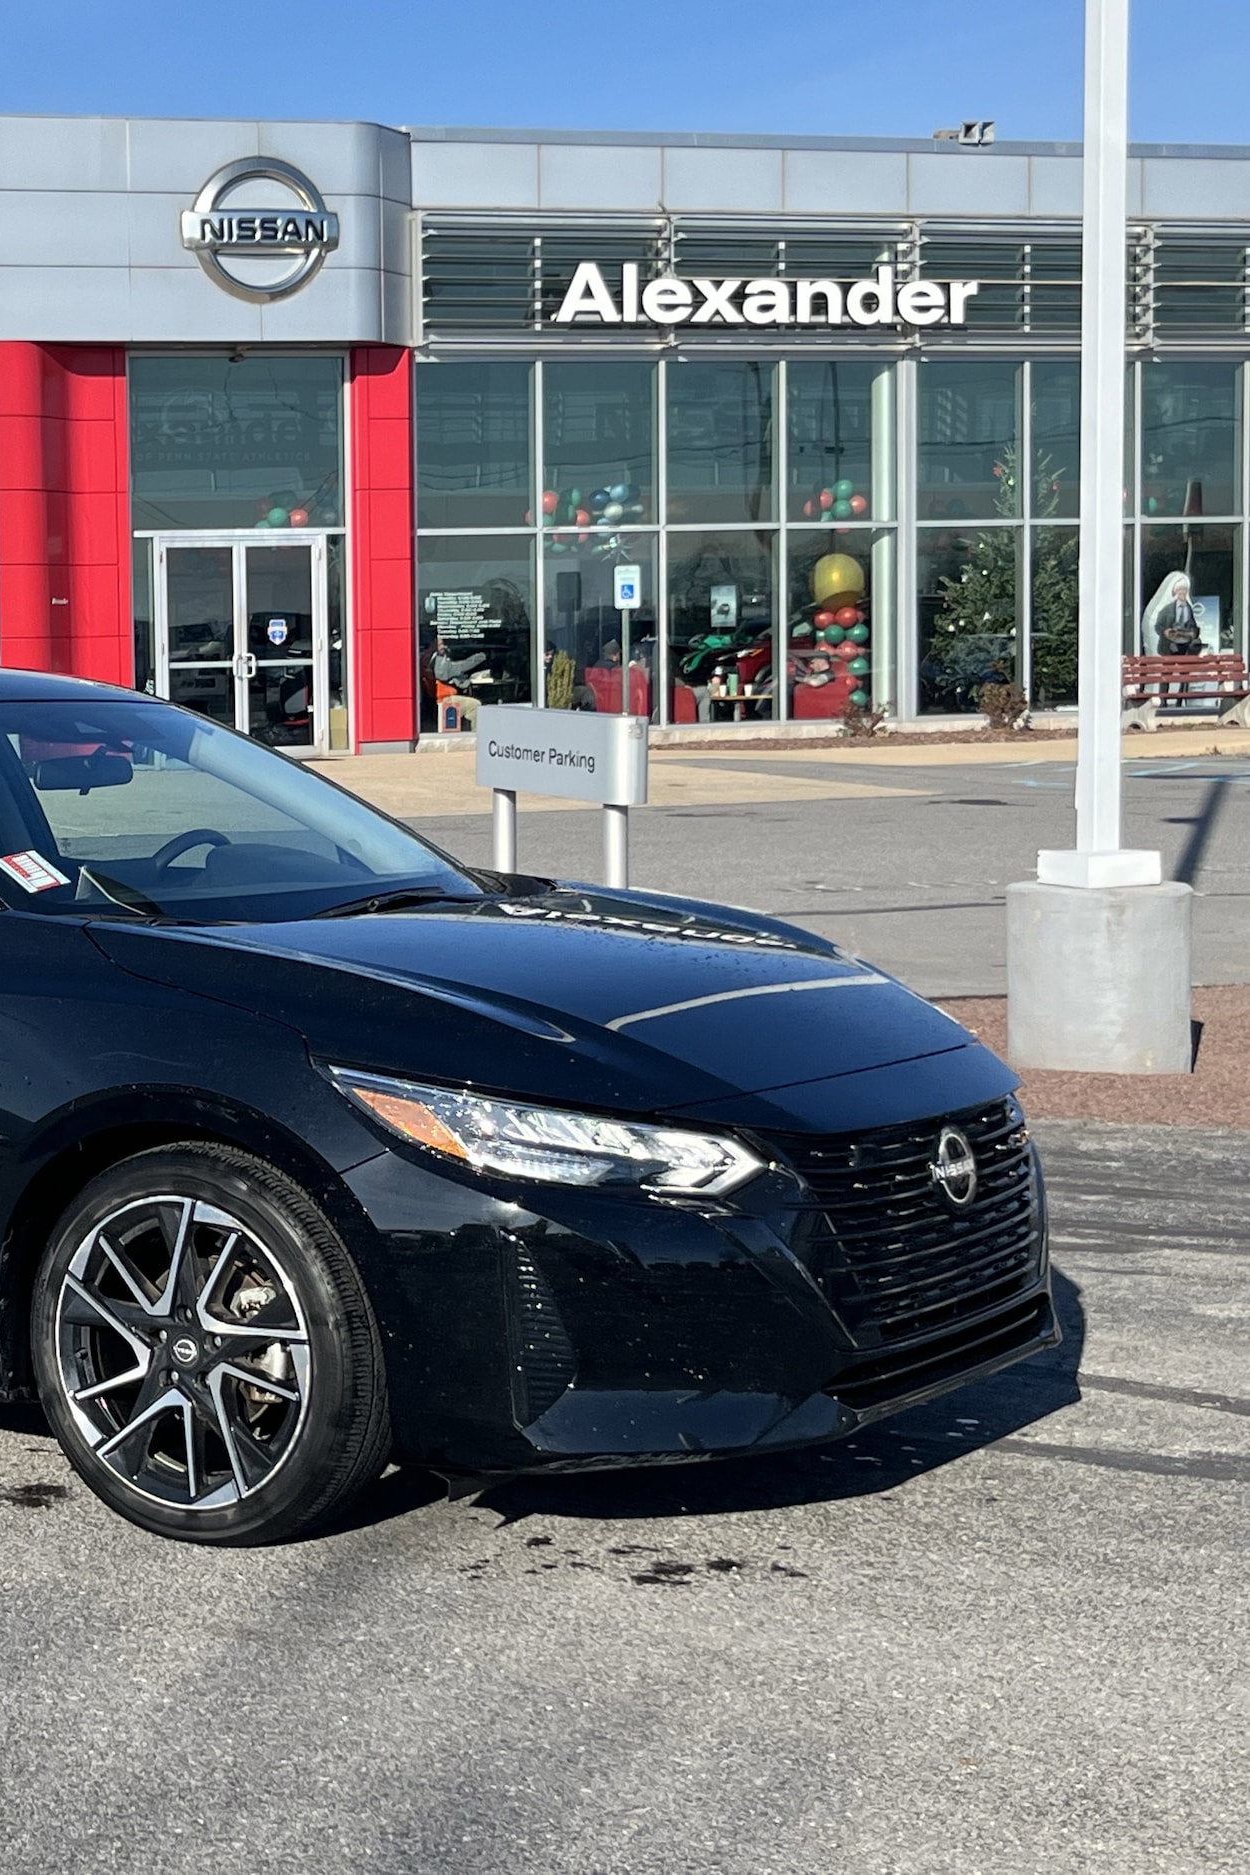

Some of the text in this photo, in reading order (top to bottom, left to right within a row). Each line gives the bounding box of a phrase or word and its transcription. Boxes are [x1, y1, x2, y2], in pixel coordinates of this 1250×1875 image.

[200, 217, 327, 242] NISSAN
[554, 262, 979, 325] Alexander
[488, 740, 596, 774] Customer Parking
